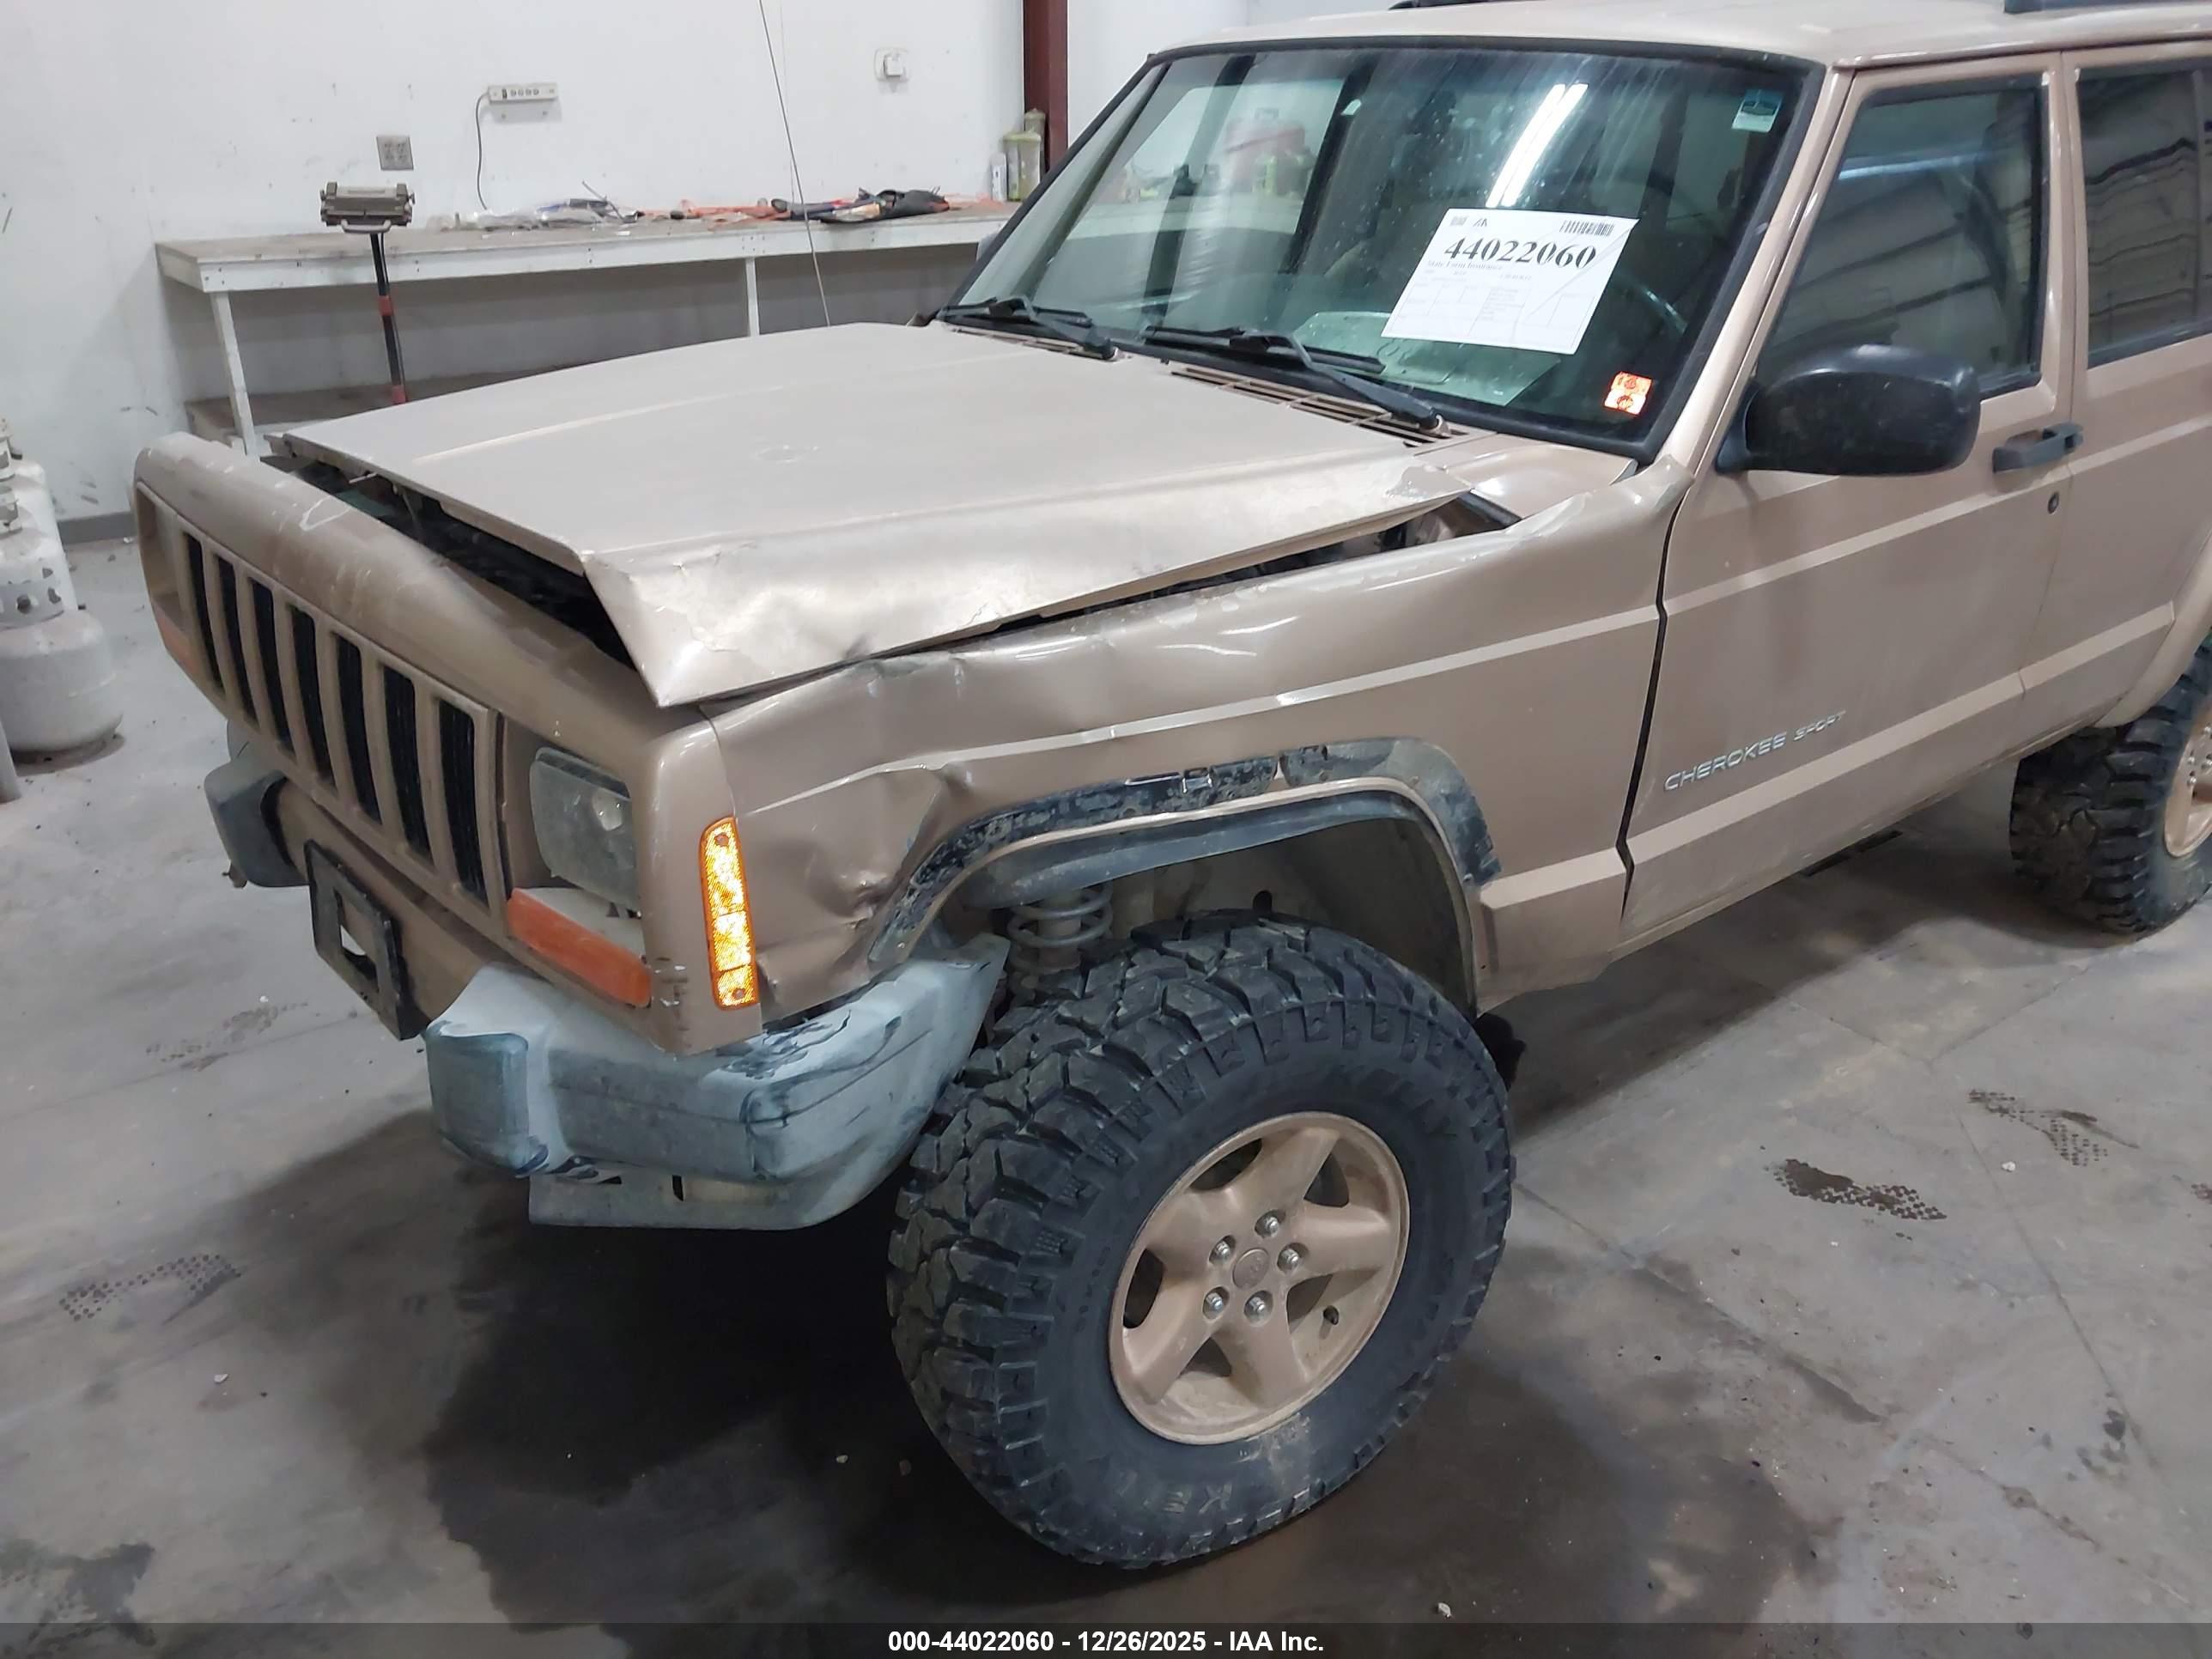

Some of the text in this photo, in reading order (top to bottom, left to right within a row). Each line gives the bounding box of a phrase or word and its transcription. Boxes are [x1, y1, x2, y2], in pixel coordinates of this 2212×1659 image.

[1443, 237, 1596, 268] 44022060
[1664, 709, 1846, 791] CHEROKEE SPORT
